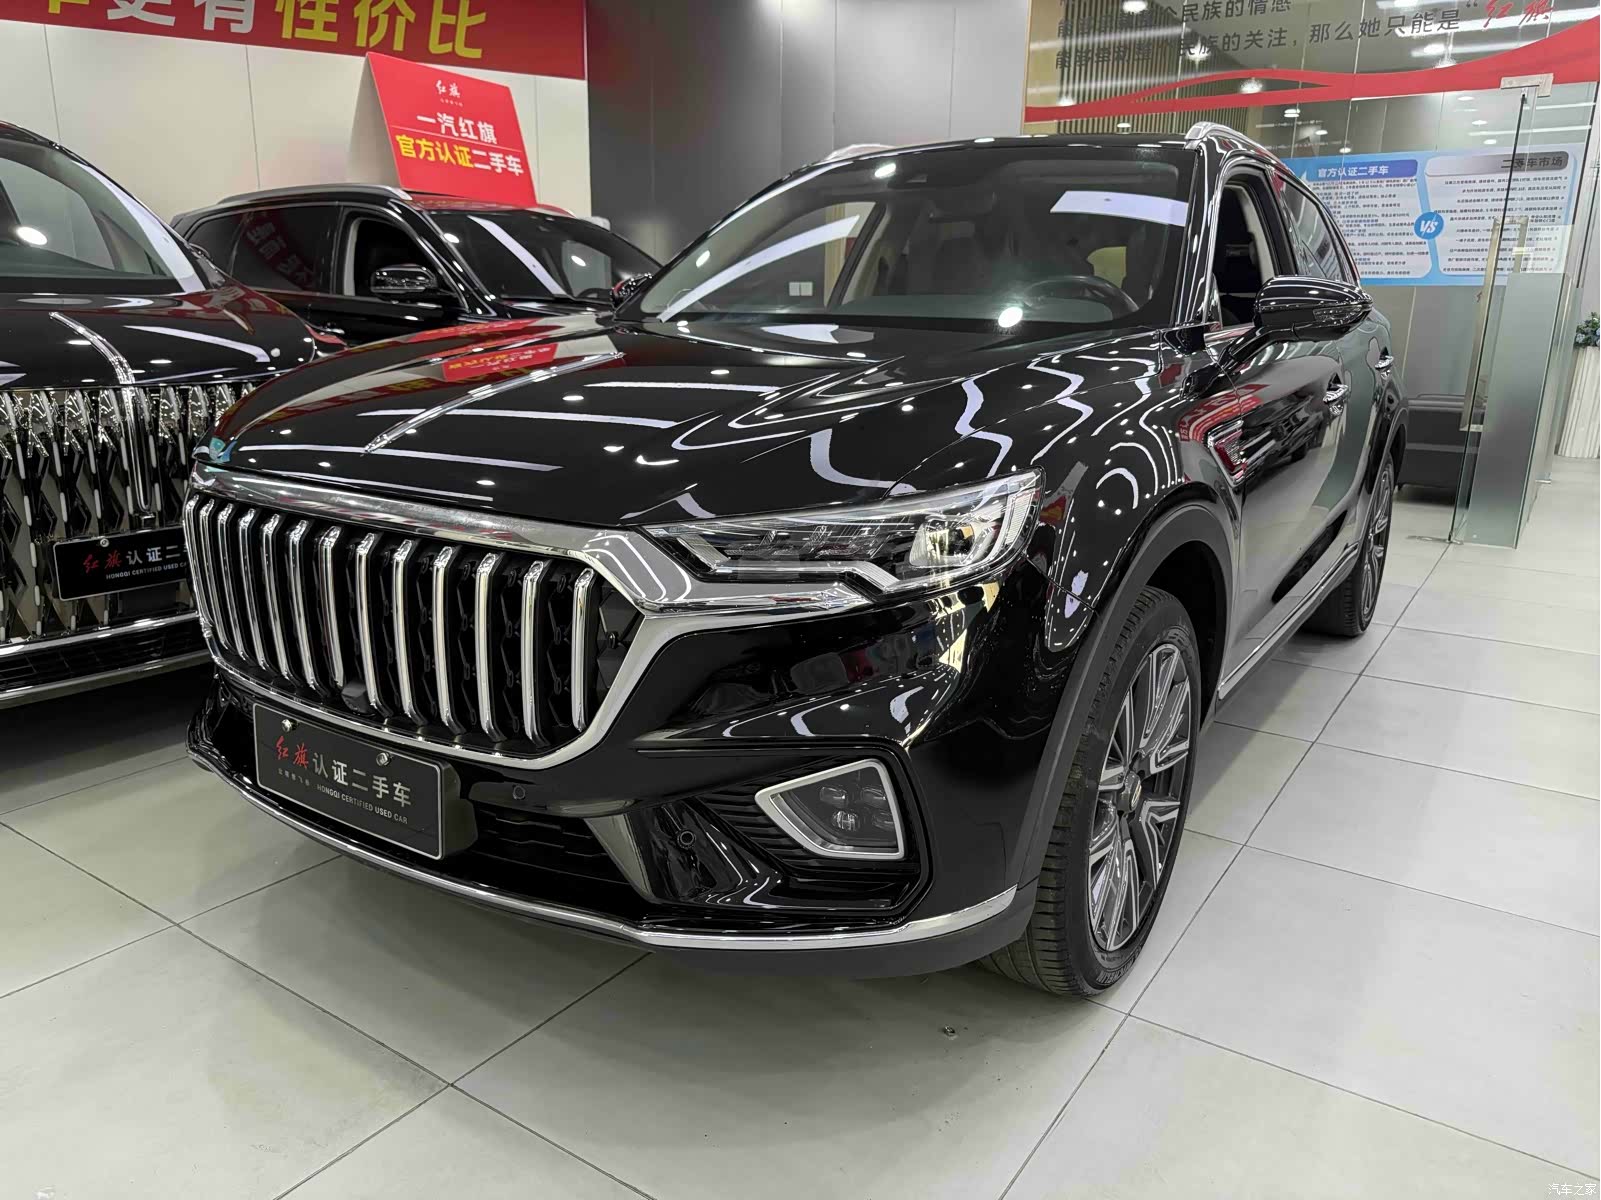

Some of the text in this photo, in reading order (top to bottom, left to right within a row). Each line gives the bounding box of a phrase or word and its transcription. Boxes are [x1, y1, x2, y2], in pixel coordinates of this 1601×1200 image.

[435, 80, 461, 98] 红旗
[416, 112, 497, 145] 一汽红旗
[395, 134, 524, 177] 官方认证二手车
[1318, 165, 1389, 178] 官方认证二手车
[1419, 220, 1439, 237] VS
[105, 571, 131, 580] HONGQI
[132, 565, 162, 576] CERTIFIED
[163, 563, 179, 571] USED
[275, 735, 412, 808] 红旗认证二手车
[317, 783, 408, 825] HONGQI CERTIFIED USED CAR
